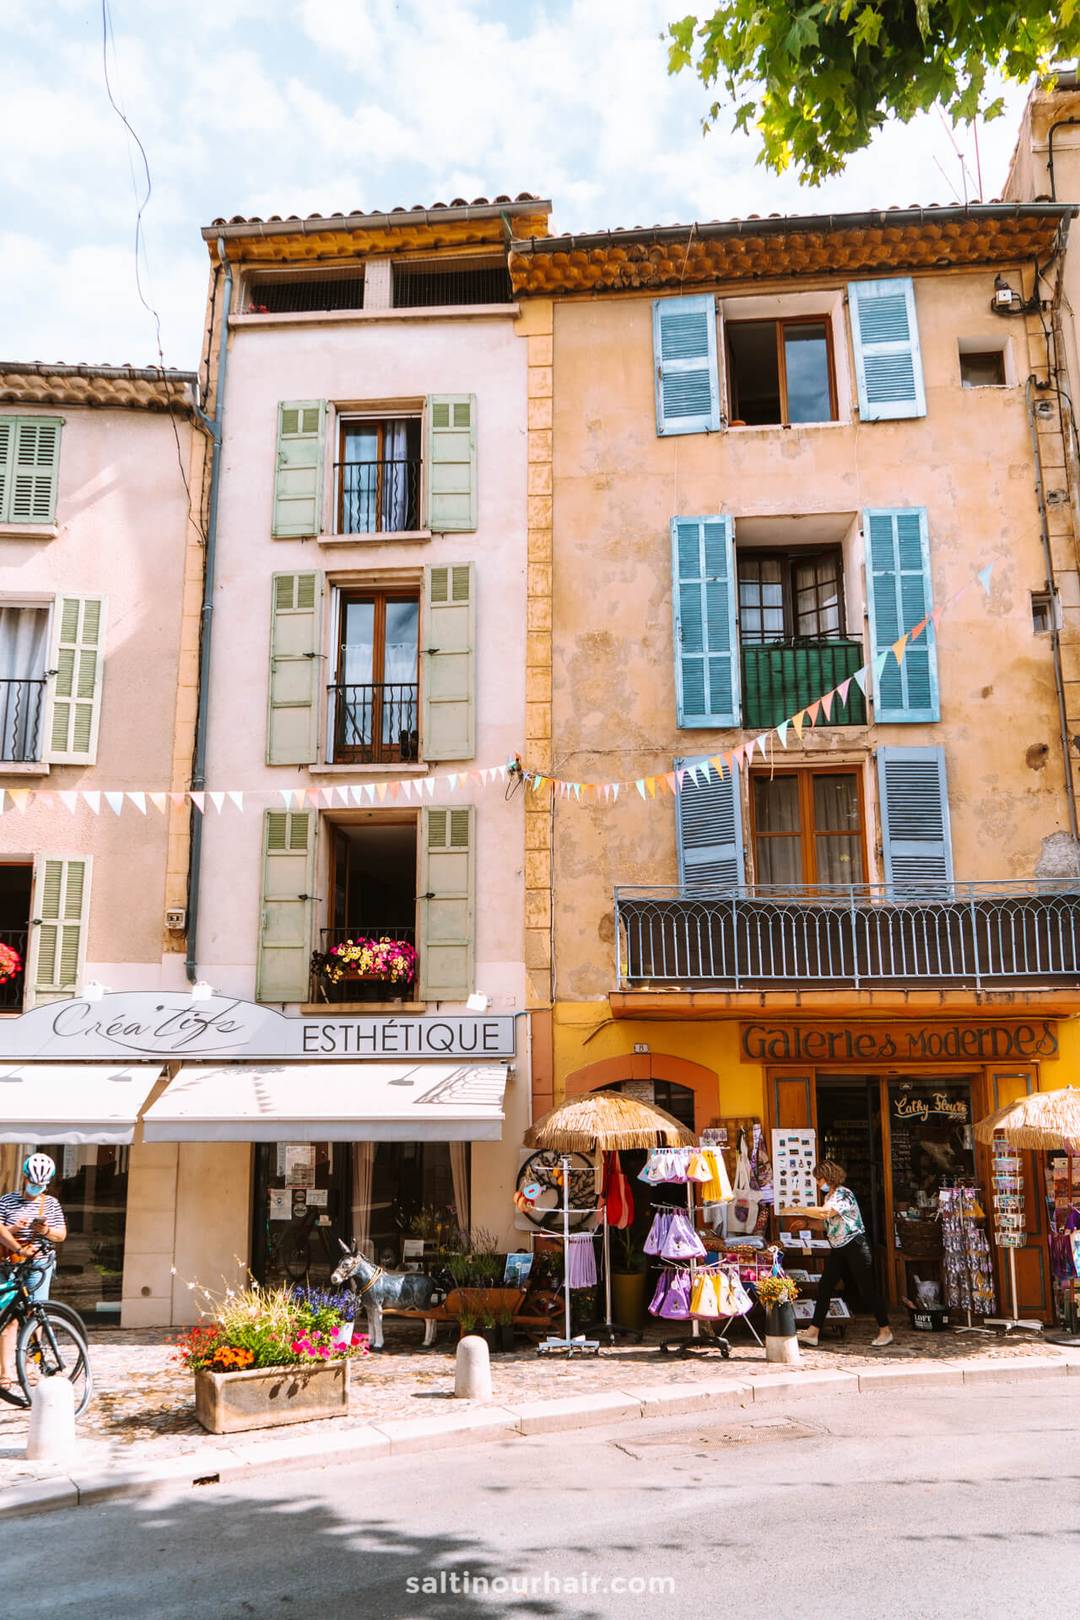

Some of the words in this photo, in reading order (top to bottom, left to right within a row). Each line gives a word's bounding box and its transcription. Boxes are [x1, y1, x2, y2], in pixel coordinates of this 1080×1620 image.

[303, 1019, 499, 1053] ESTHÉTIQUE
[742, 1025, 897, 1059] Galeries
[906, 1022, 1058, 1058] Modernes
[893, 1095, 929, 1121] Cathy
